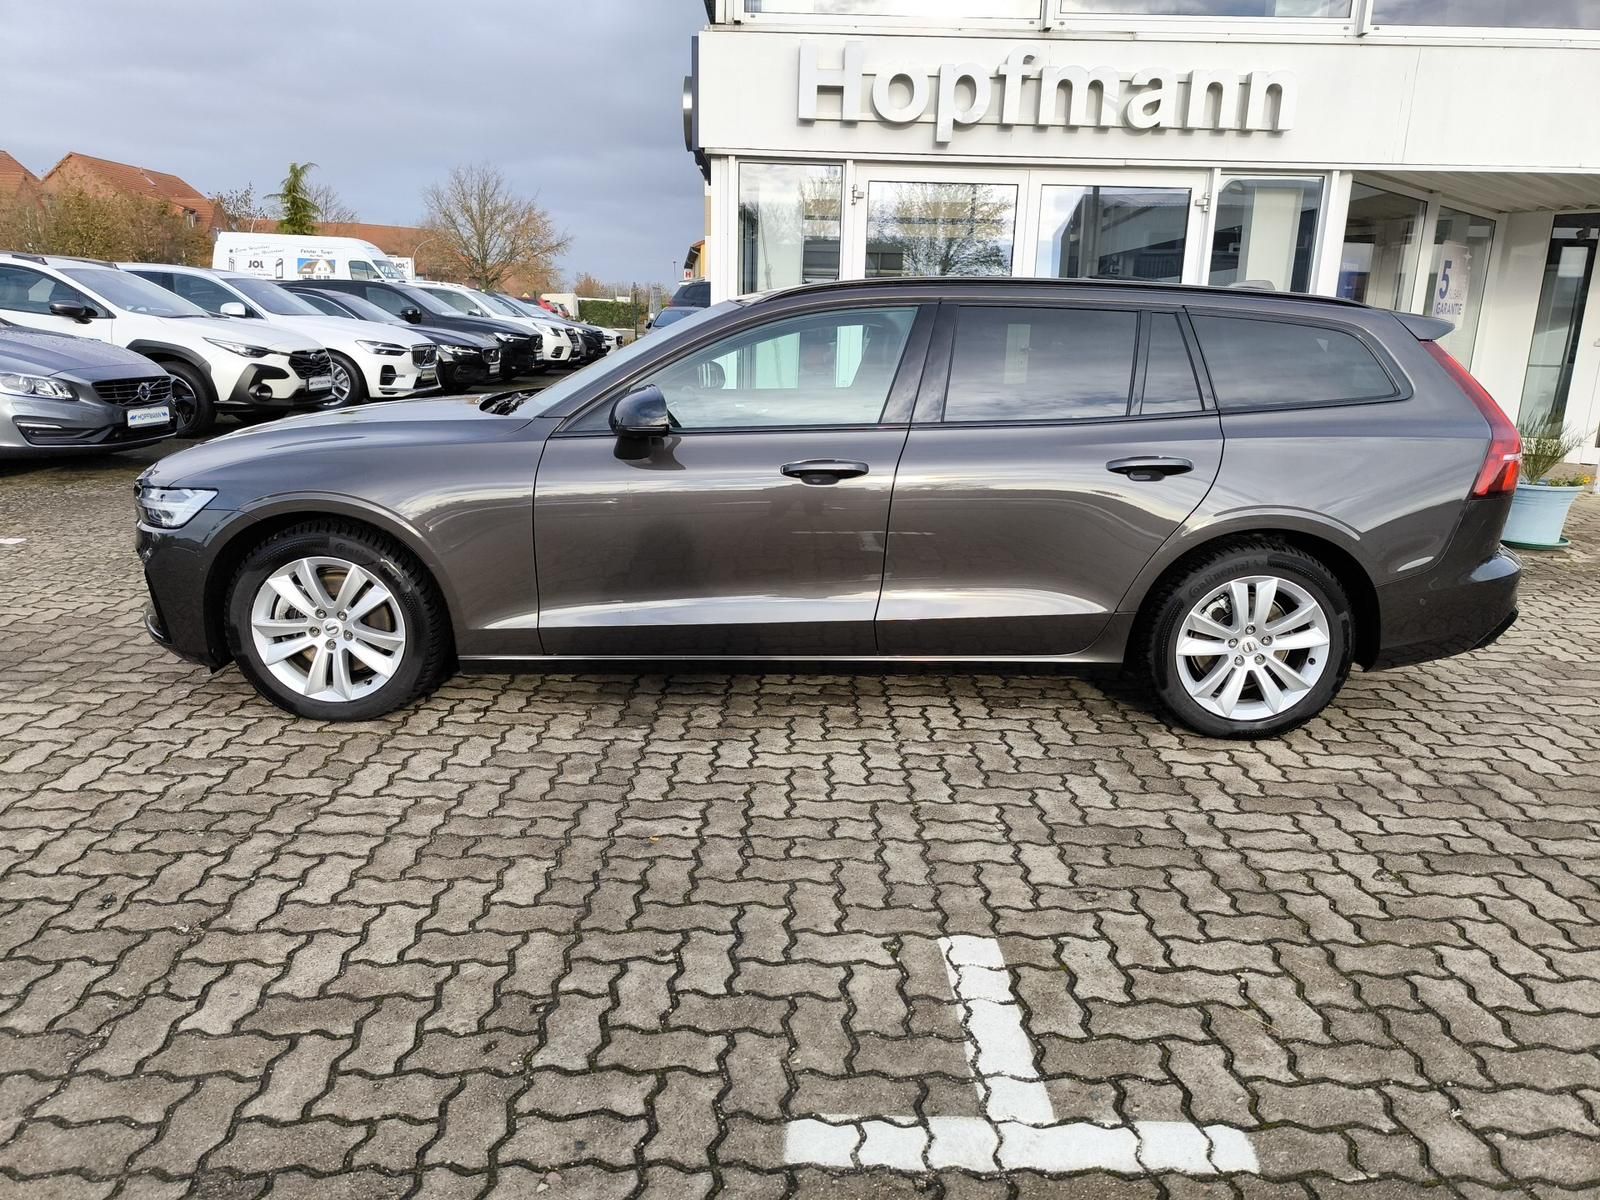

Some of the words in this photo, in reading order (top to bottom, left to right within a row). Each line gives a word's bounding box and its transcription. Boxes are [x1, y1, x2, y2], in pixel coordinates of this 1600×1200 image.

[798, 40, 1297, 143] Hopfmann
[1439, 260, 1452, 299] 5
[1435, 302, 1463, 315] GARANTIE
